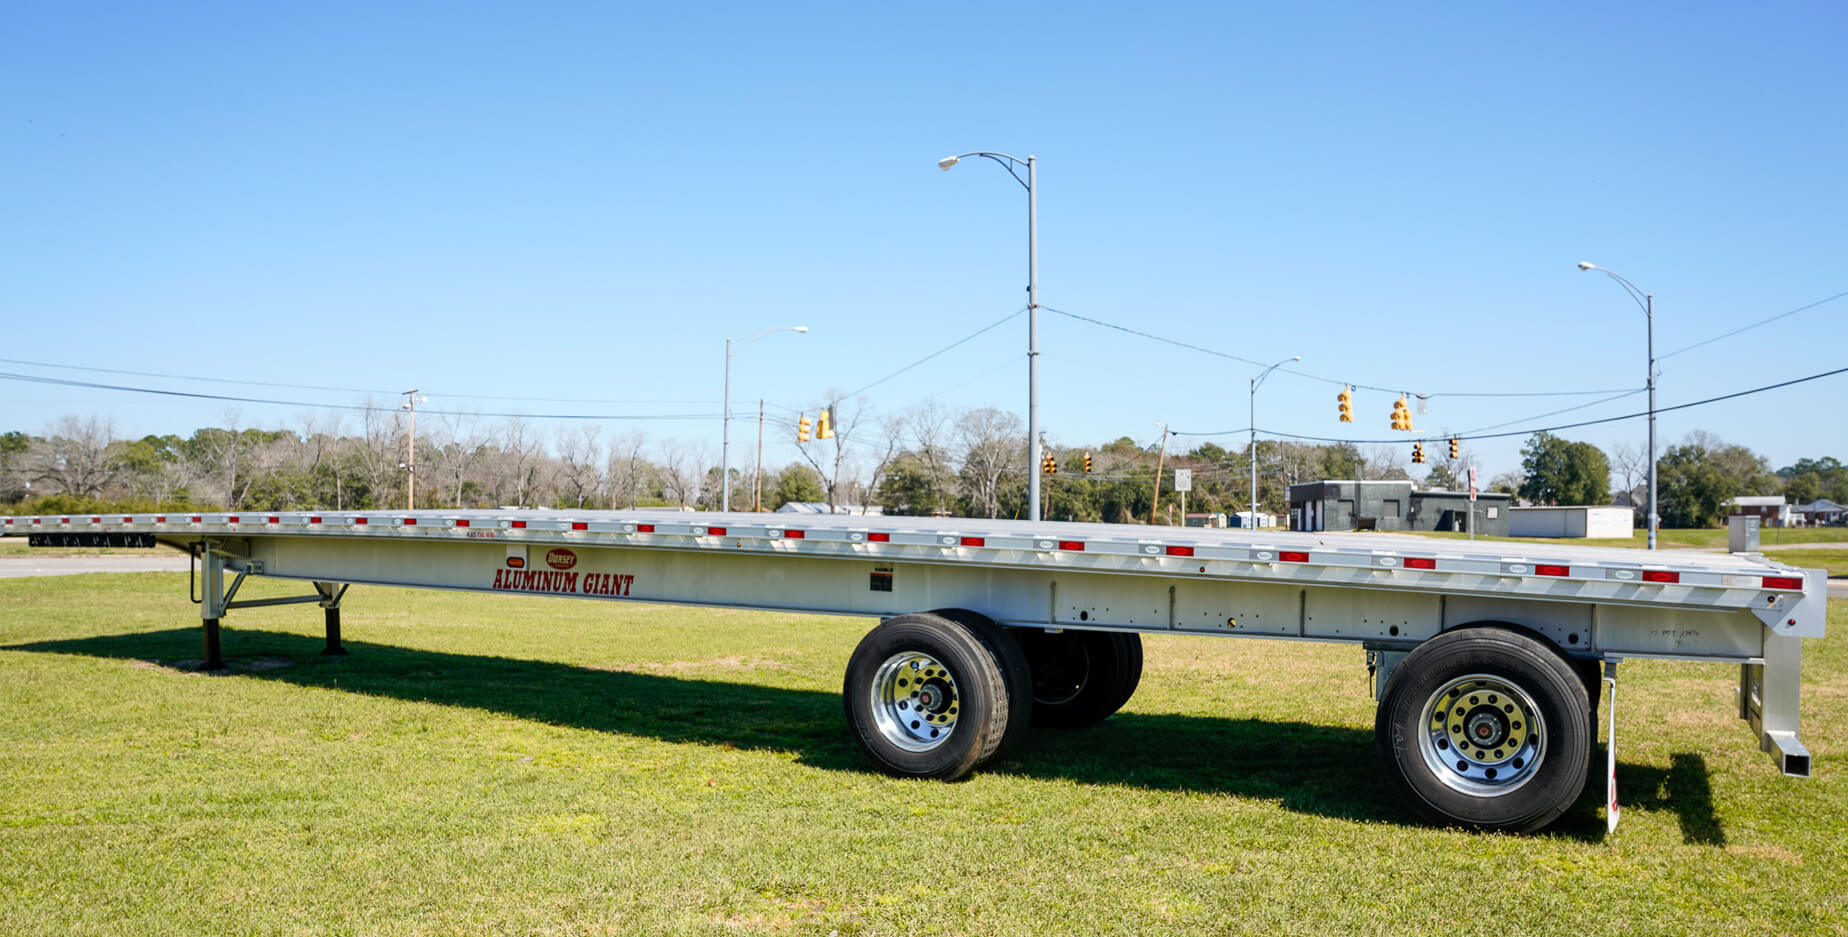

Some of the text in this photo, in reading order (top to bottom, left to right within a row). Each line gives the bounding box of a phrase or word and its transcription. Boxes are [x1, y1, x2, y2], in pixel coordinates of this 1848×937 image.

[547, 552, 575, 564] DORSEY
[493, 569, 635, 596] ALUMINUM GIANT
